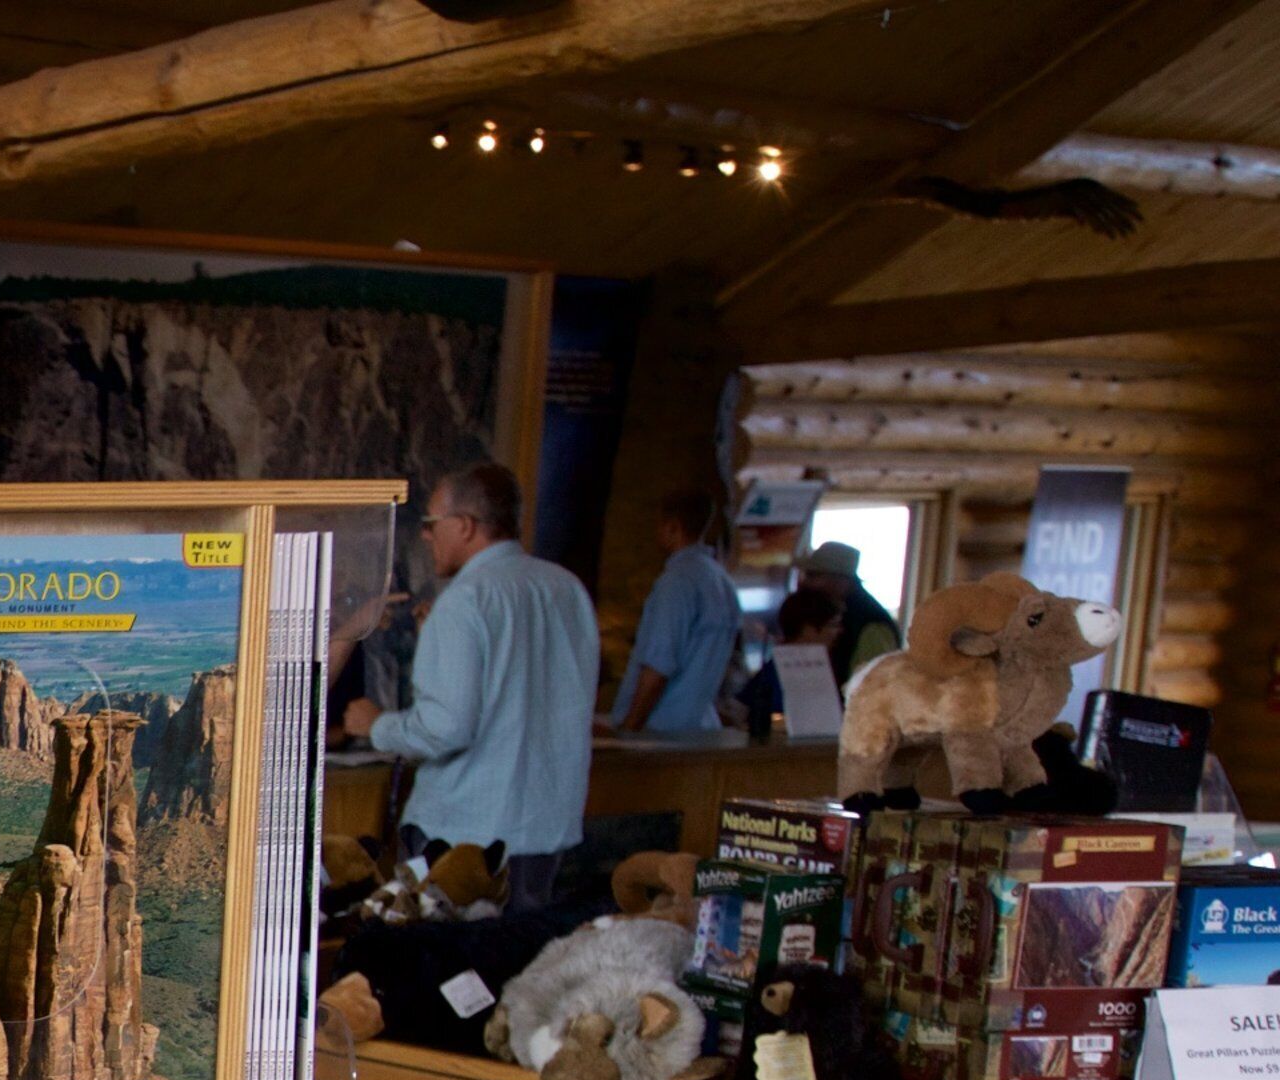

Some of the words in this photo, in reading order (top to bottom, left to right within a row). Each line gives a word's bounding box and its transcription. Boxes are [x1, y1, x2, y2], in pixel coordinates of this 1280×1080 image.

[192, 540, 233, 550] NEW
[1034, 521, 1104, 565] FIND
[9, 604, 77, 613] MONUMENT
[31, 620, 56, 629] THE
[722, 811, 777, 836] National
[778, 819, 817, 843] Parks
[1077, 839, 1103, 849] Black
[1105, 840, 1142, 850] Canyon
[697, 870, 739, 890] Yahtzee
[774, 886, 835, 911] Yahtzee
[1234, 907, 1277, 922] Black
[1233, 925, 1252, 934] The
[1098, 1002, 1136, 1016] 1000
[1187, 1050, 1214, 1058] Great
[1217, 1049, 1248, 1057] Pillars
[1240, 1066, 1263, 1074] Now
